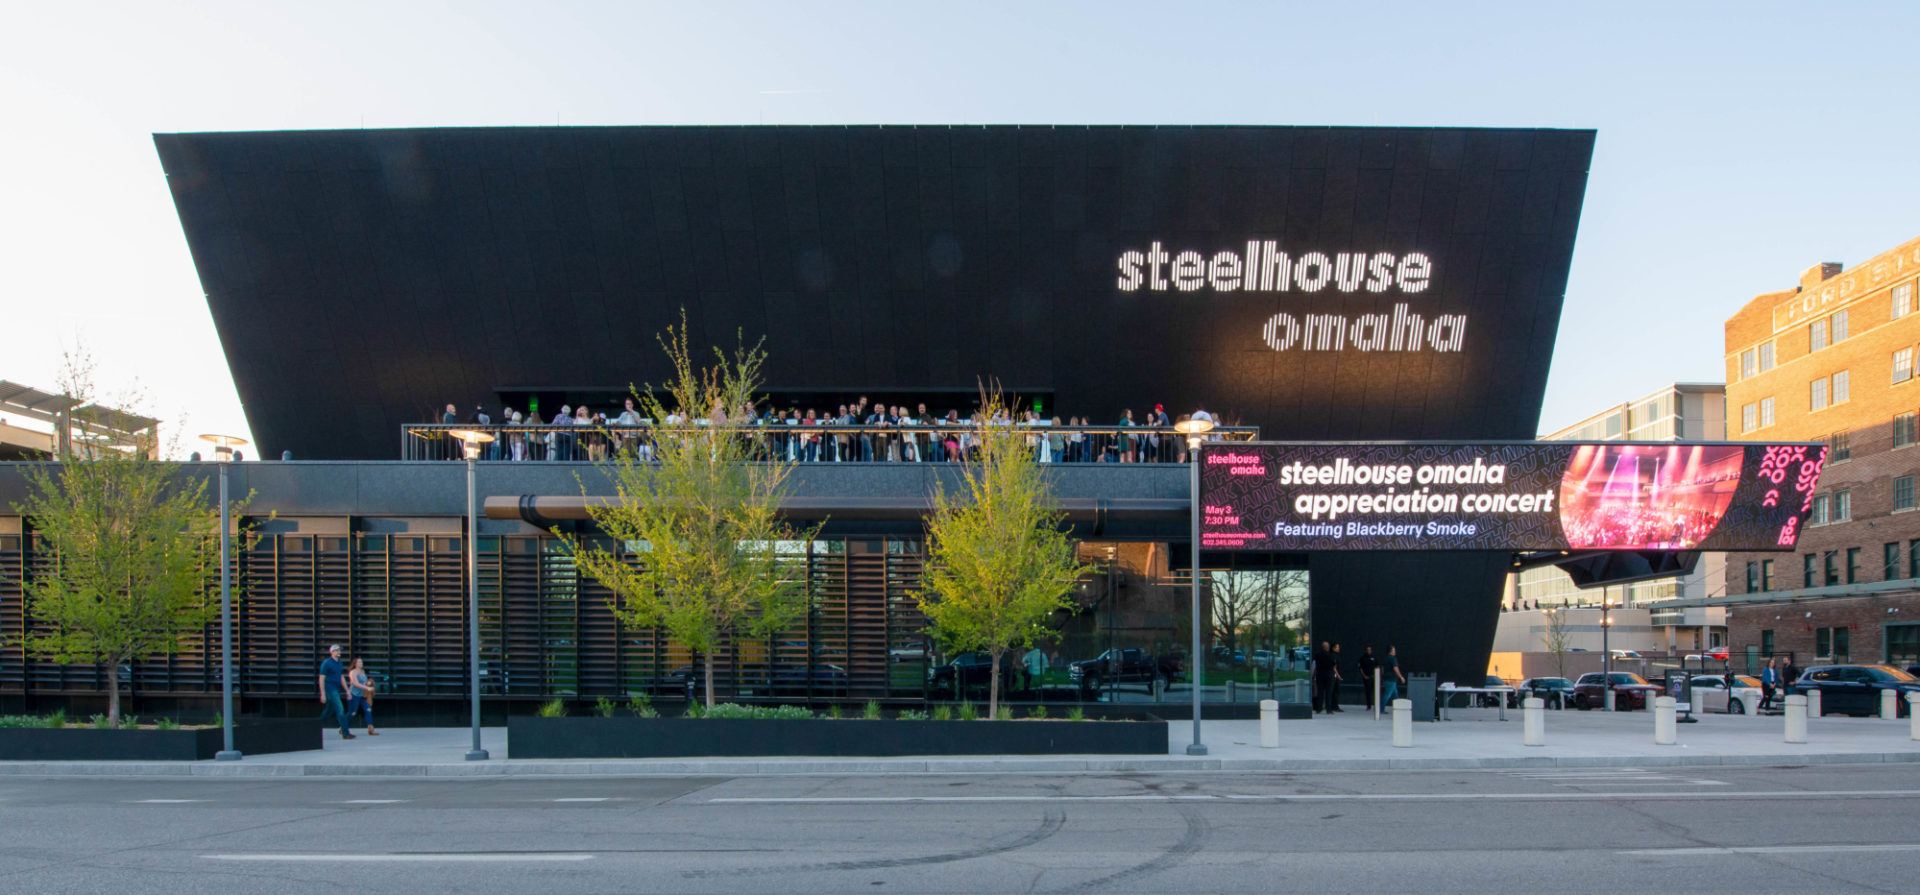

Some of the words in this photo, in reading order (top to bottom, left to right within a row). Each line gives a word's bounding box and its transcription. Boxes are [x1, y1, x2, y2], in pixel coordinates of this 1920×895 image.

[1118, 240, 1432, 293] steelhouse
[1788, 278, 1856, 319] FORD
[1262, 303, 1467, 352] omaha
[1207, 453, 1260, 464] steelhouse
[1230, 464, 1266, 475] omaha
[1280, 458, 1413, 485] steelhouse
[1416, 457, 1506, 485] omaha
[1205, 505, 1224, 516] May
[1225, 505, 1232, 514] 3
[1294, 487, 1458, 520] appreciation
[1461, 489, 1555, 513] concert
[1205, 516, 1223, 525] 7:30
[1224, 516, 1240, 525] PM
[1275, 521, 1344, 539] Featuring
[1345, 521, 1424, 539] Blackberry
[1426, 521, 1477, 536] Smoke
